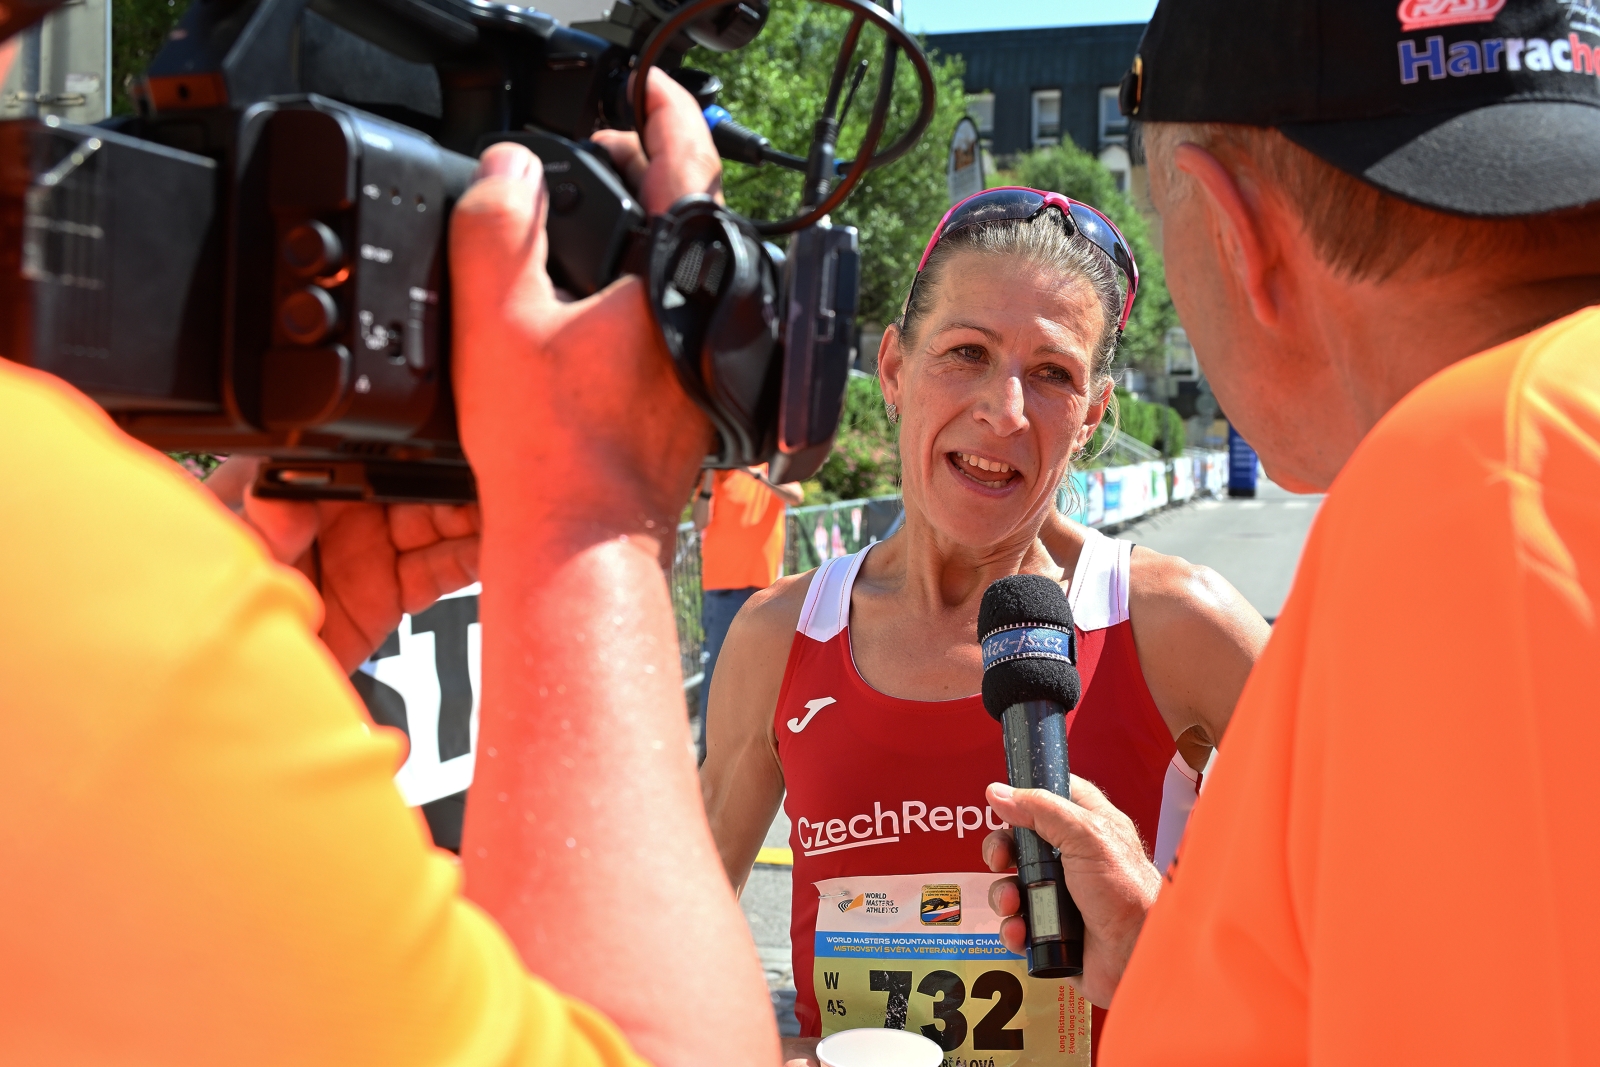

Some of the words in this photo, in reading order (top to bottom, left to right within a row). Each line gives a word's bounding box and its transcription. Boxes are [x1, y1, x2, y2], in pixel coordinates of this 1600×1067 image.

[864, 892, 887, 900] WORLD
[826, 936, 852, 944] WORLD
[853, 937, 890, 945] MASTERS
[833, 945, 883, 953] MISTROVSTVÍ
[914, 946, 959, 954] VETERÁNŮ
[824, 971, 839, 989] W
[1057, 985, 1065, 1002] Race
[826, 999, 847, 1017] 45
[869, 969, 1024, 1052] 732
[1077, 996, 1085, 1015] 2026
[1058, 1003, 1066, 1034] Distance
[1068, 1014, 1077, 1031] long
[1078, 1016, 1085, 1024] 6.
[1058, 1035, 1067, 1053] Long
